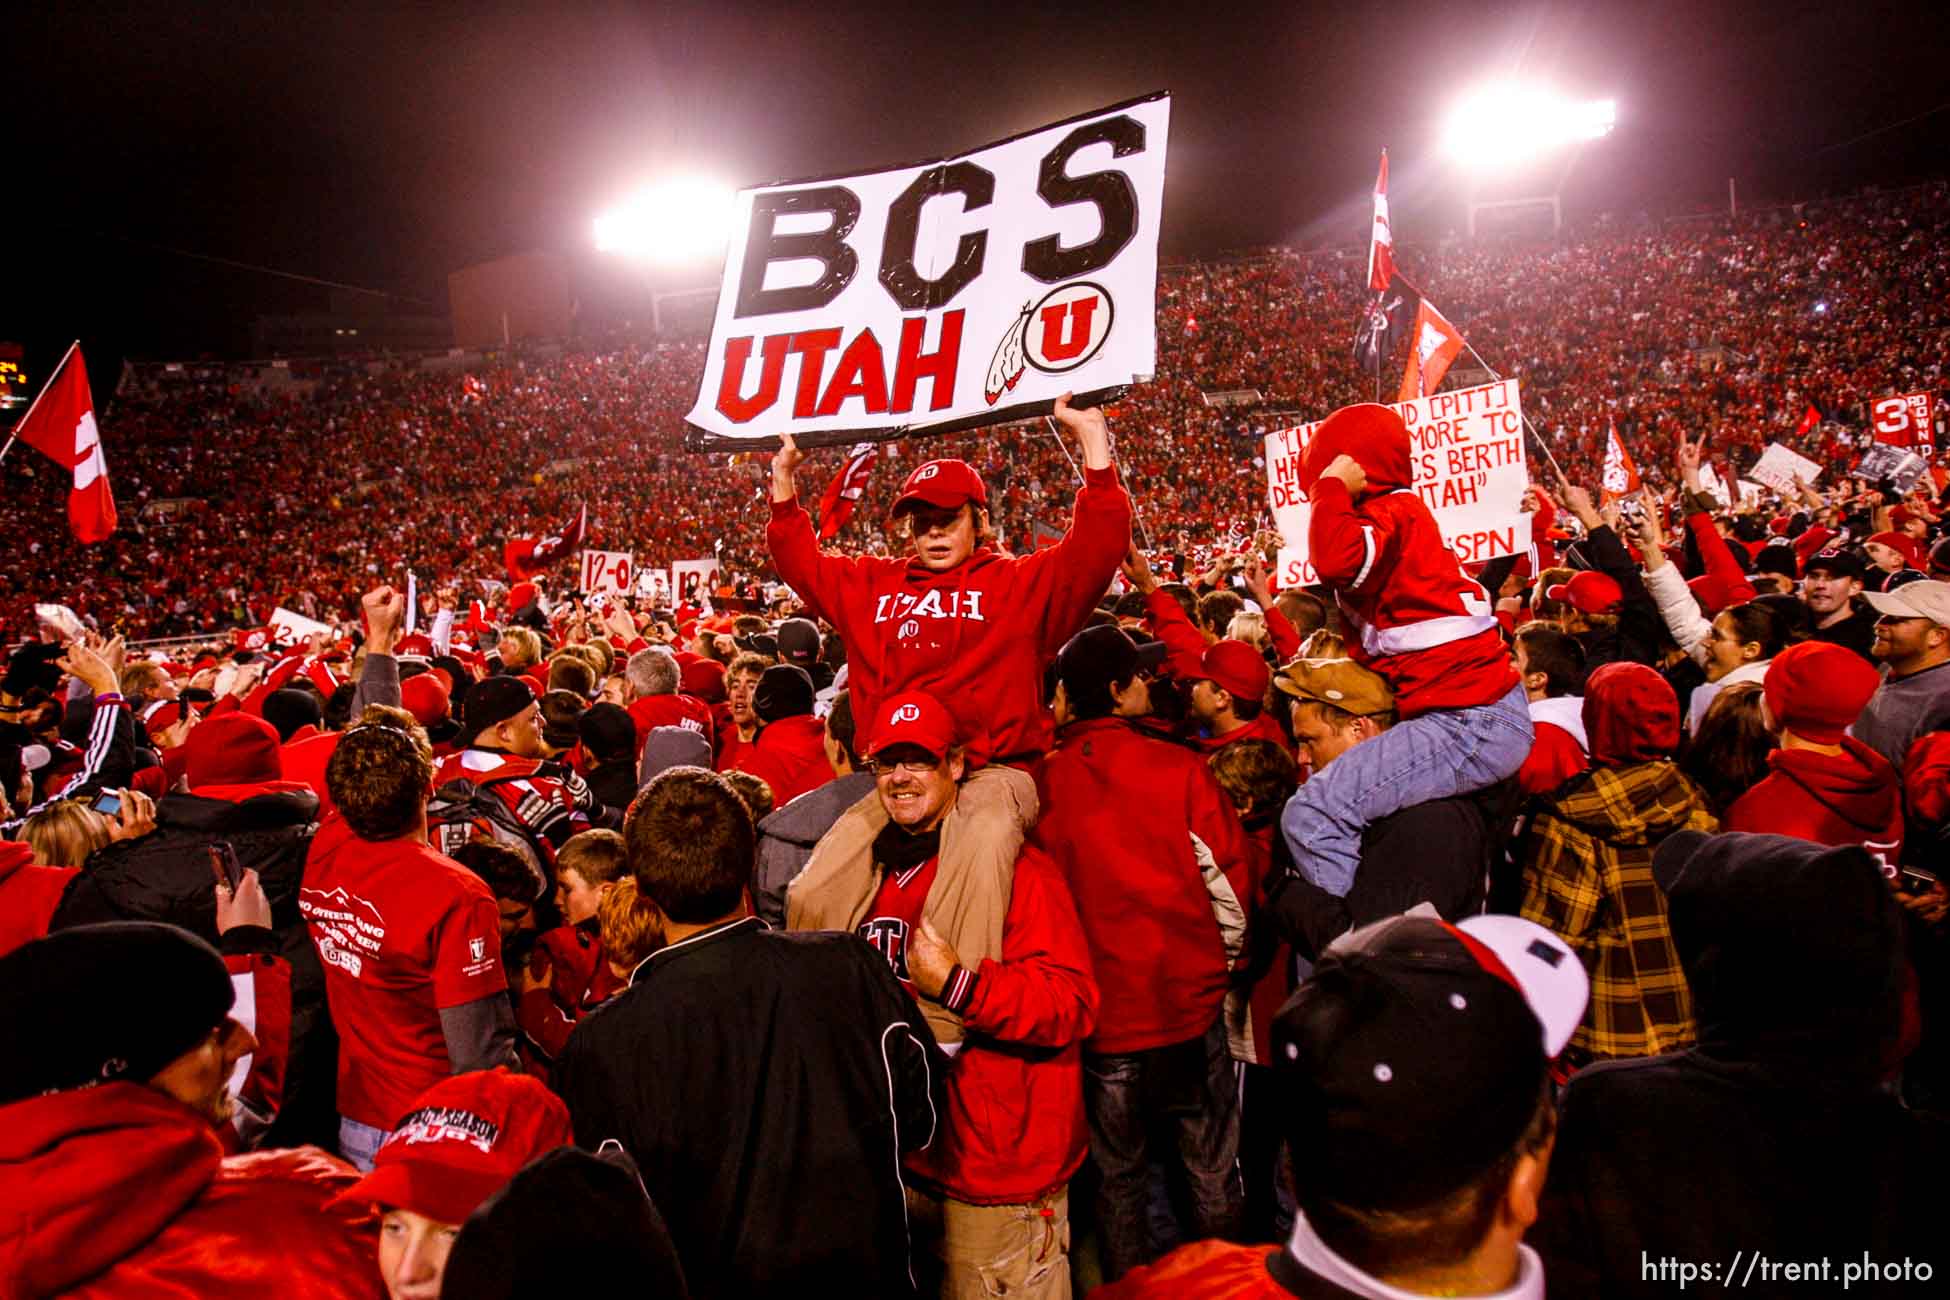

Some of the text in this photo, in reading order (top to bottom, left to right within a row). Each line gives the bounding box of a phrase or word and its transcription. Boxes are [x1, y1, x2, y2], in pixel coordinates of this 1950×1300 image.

[733, 114, 1146, 318] BCS
[1040, 295, 1098, 362] U
[715, 309, 965, 424] UTAH
[1408, 417, 1471, 452] MORE
[1448, 438, 1520, 475] BERTH
[1455, 526, 1514, 562] SPN
[586, 553, 629, 591] 12-0
